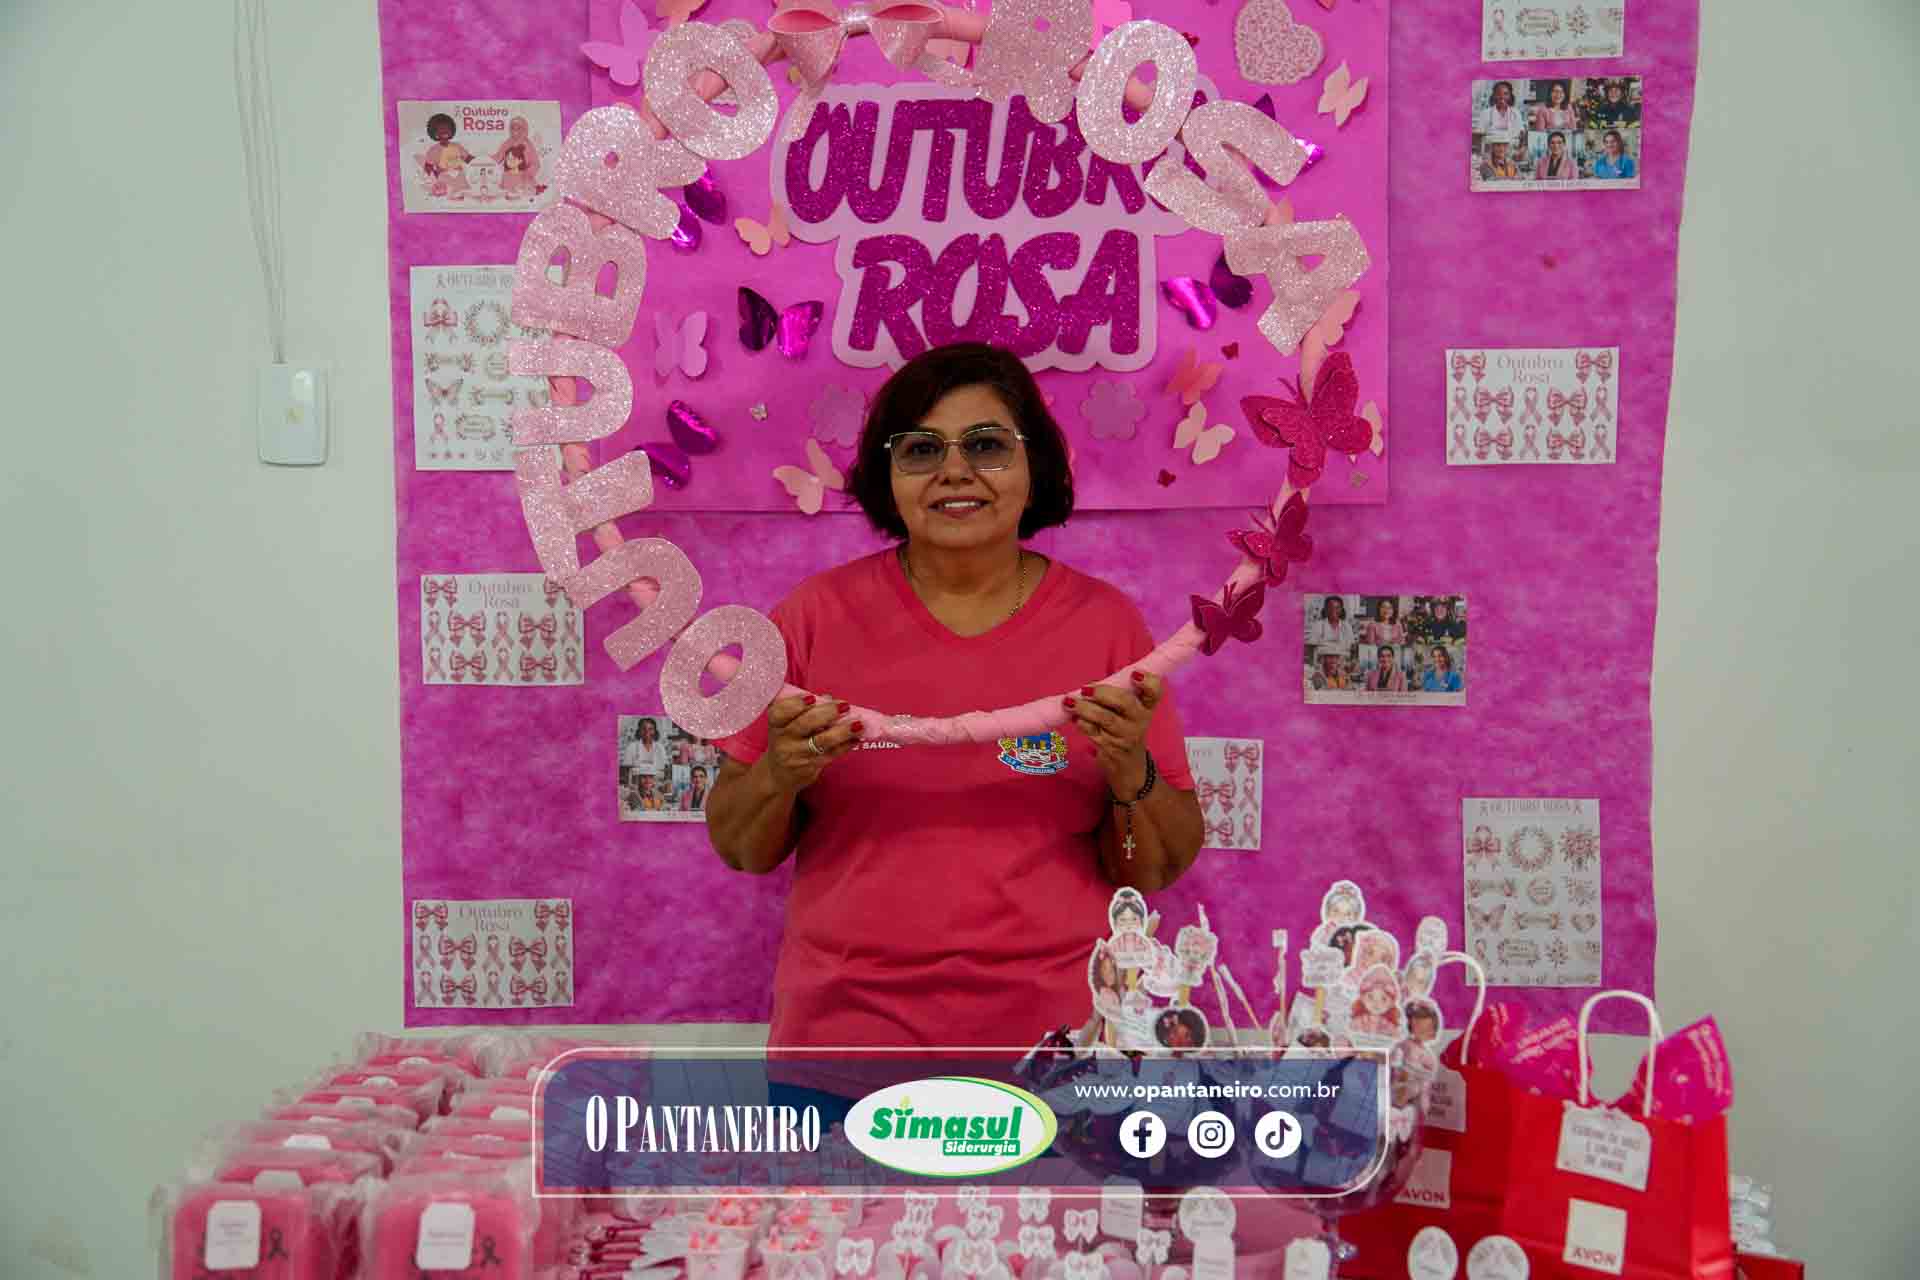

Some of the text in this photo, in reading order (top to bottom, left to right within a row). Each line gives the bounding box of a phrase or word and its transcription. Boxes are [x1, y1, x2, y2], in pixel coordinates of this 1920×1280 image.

[462, 106, 509, 117] Outubro
[463, 117, 505, 131] Rosa
[848, 230, 1139, 361] ROSA
[1572, 1246, 1617, 1267] AVON
